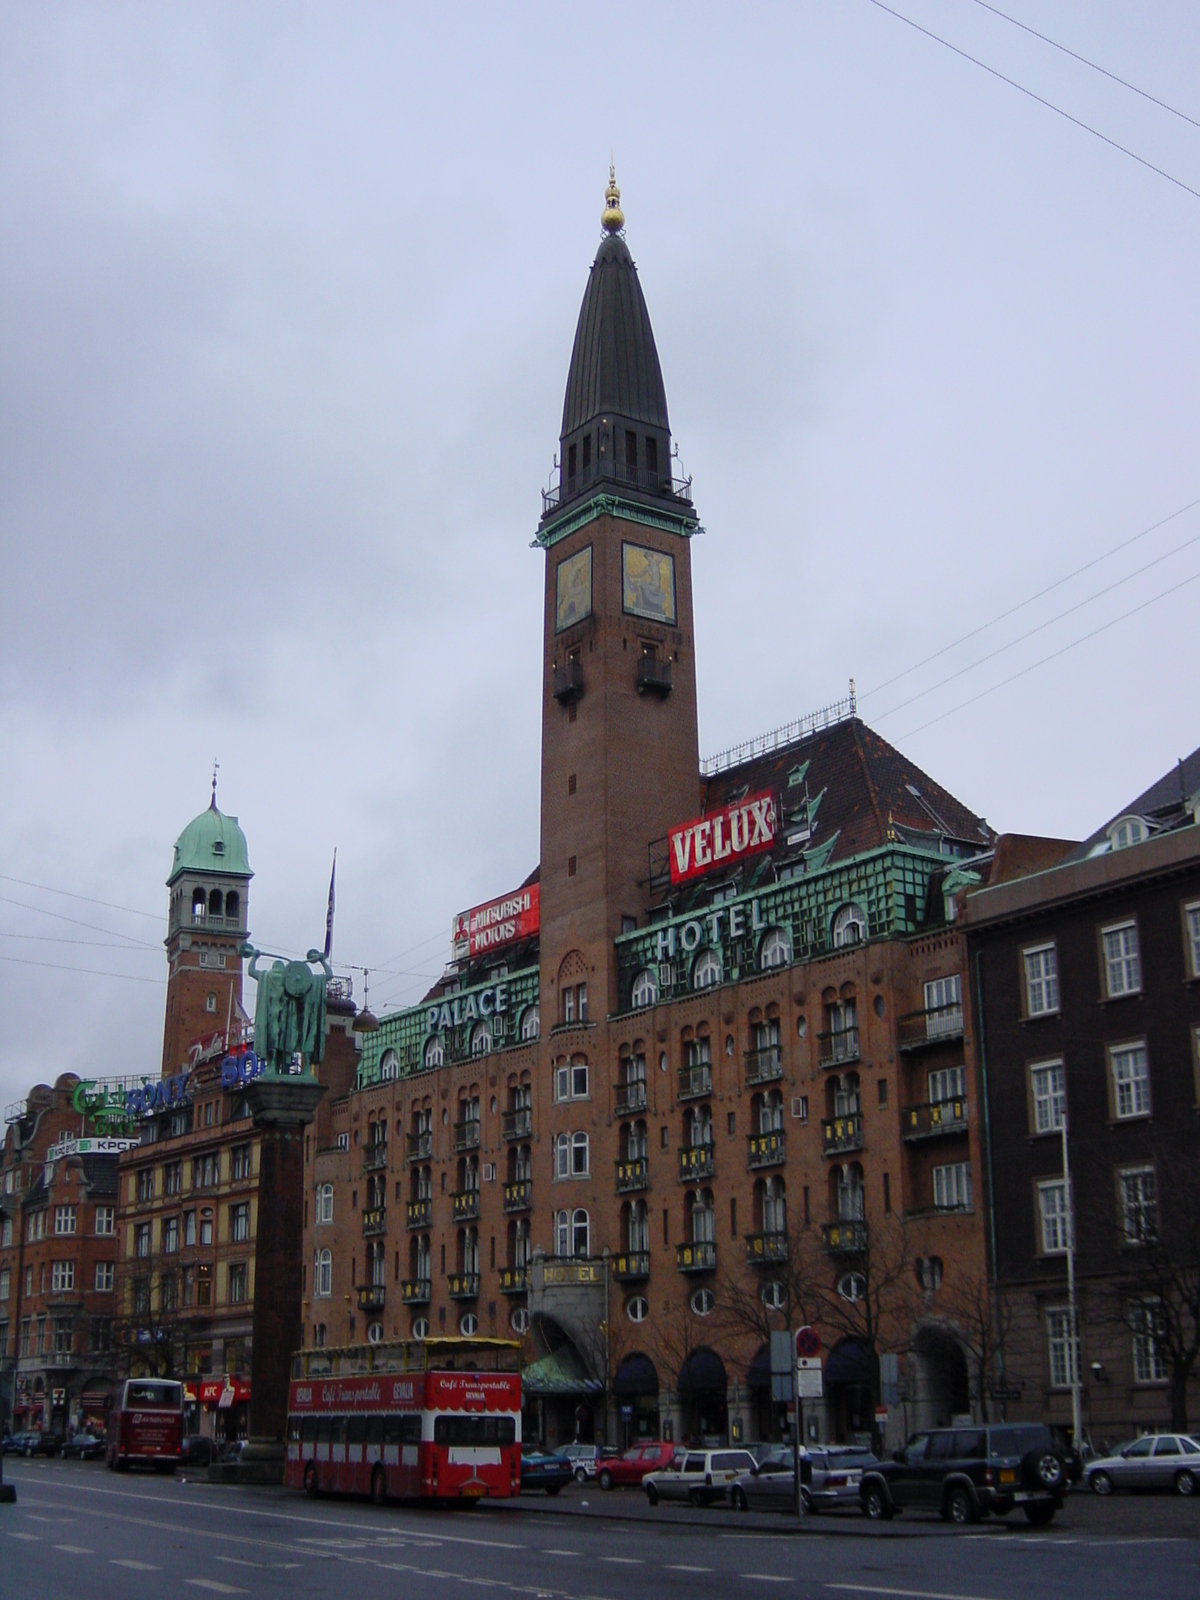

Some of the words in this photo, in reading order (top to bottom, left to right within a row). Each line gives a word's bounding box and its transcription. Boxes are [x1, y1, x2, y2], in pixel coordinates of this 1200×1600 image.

[671, 797, 773, 874] VELUX
[474, 893, 531, 929] MITSUBISHI
[474, 919, 516, 950] MOTORS
[656, 899, 767, 961] HOTEL
[426, 984, 508, 1033] PALACE
[126, 1072, 190, 1116] SONY
[97, 1141, 127, 1151] KPC
[543, 1266, 601, 1282] HOTEL
[204, 1386, 218, 1397] KFC
[440, 1379, 458, 1391] Café
